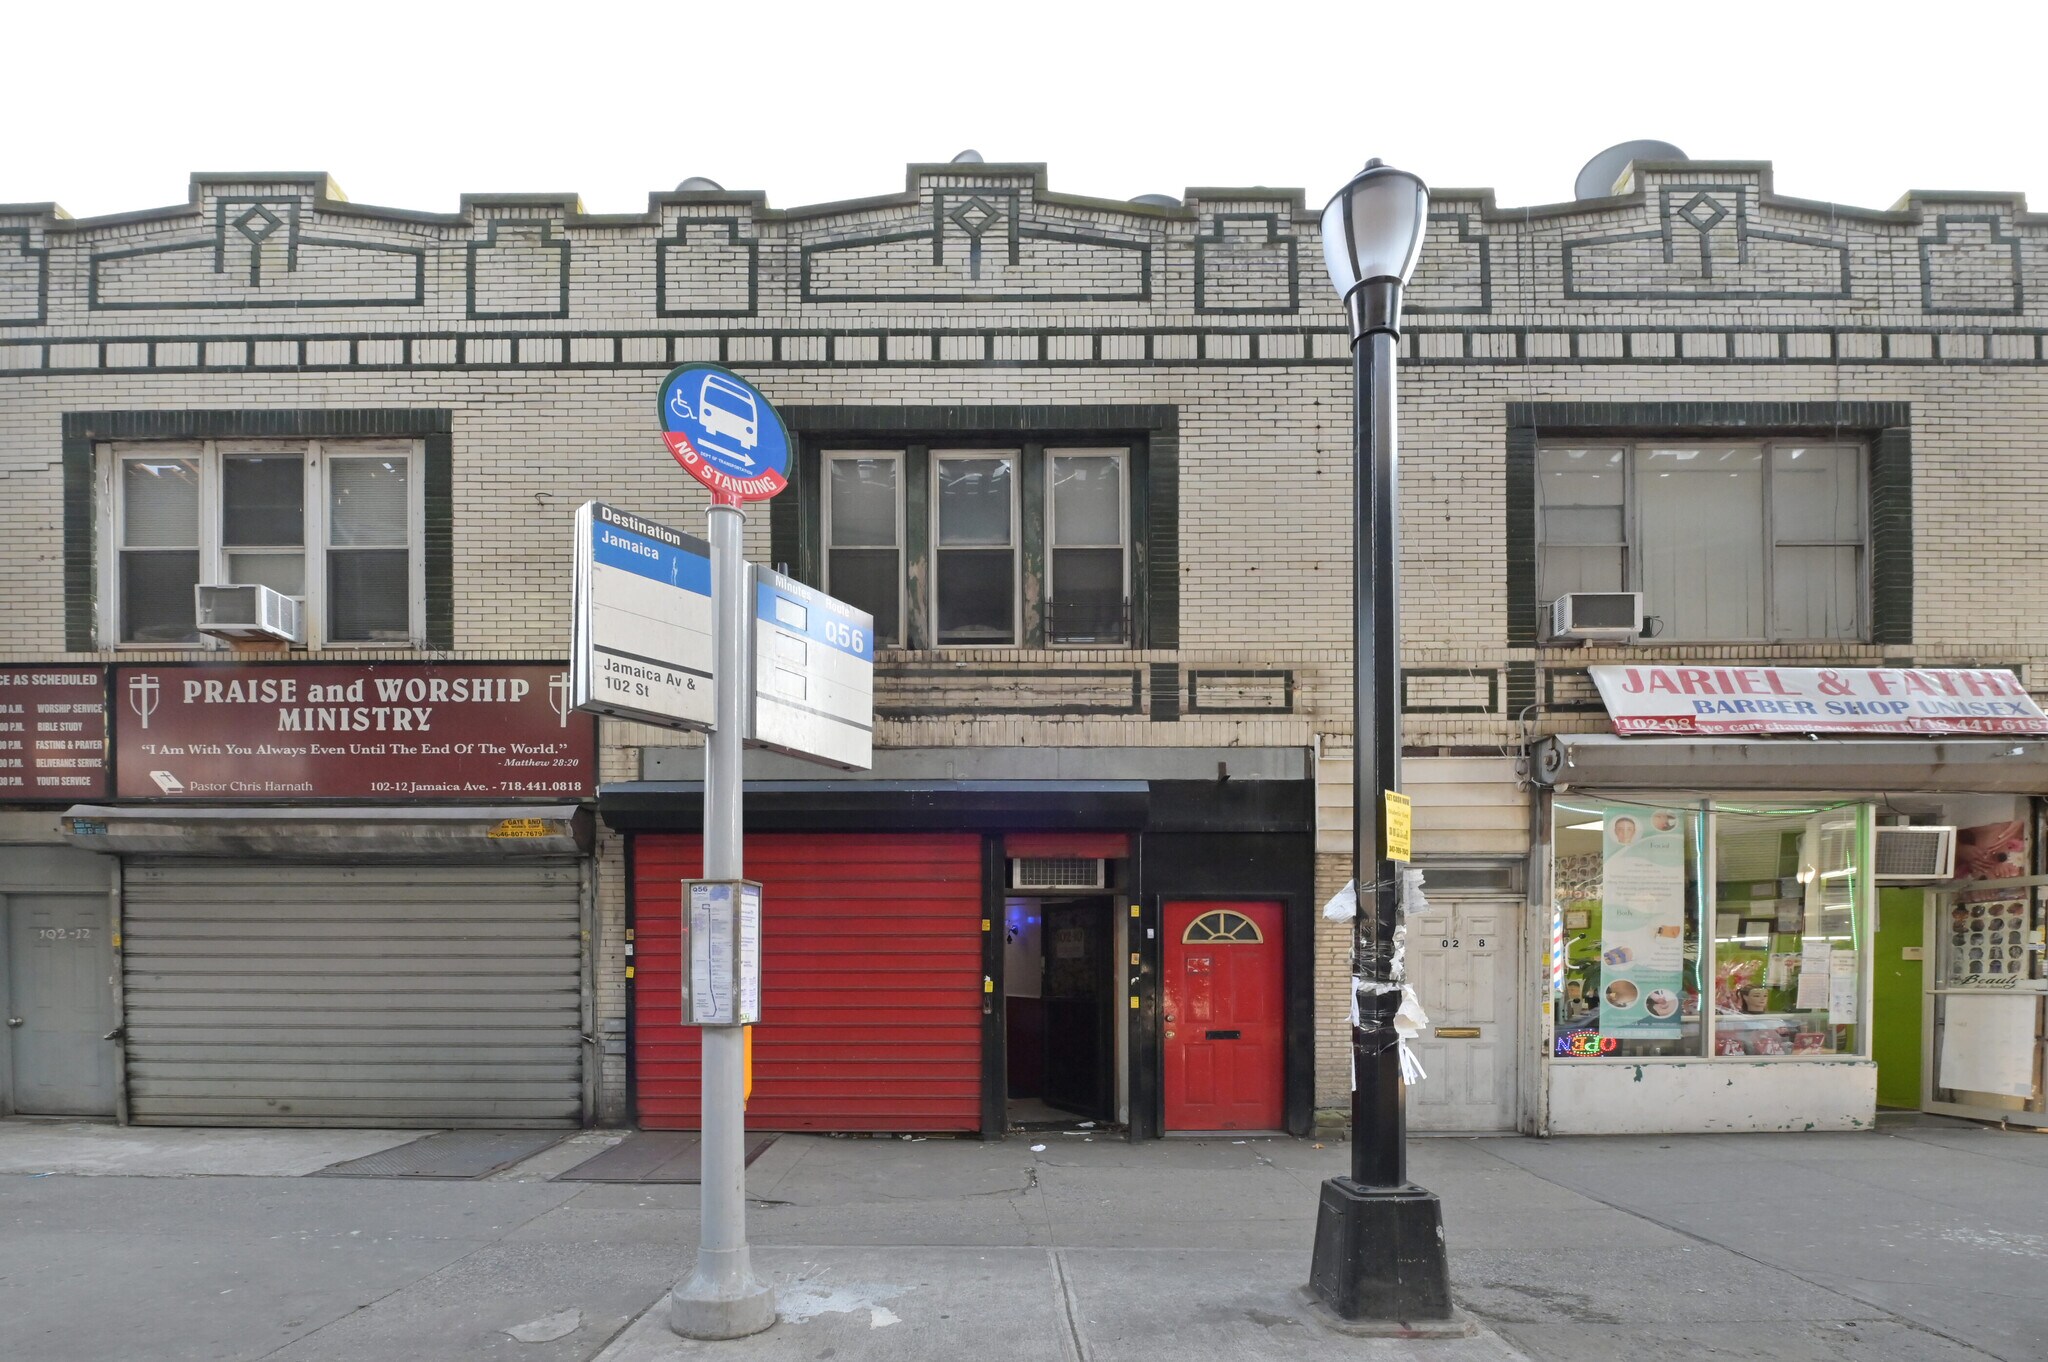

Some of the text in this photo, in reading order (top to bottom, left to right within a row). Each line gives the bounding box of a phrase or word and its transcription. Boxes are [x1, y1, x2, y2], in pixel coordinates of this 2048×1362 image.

[674, 441, 777, 495] NO STANDING
[601, 506, 681, 546] Destination
[601, 530, 660, 560] Jamaica
[775, 575, 851, 617] Minutes Route
[825, 620, 864, 653] Q56
[13, 674, 29, 686] AS
[31, 674, 98, 686] SCHEDULED
[604, 658, 696, 691] Jamaica Av &
[605, 676, 650, 697] 102 St
[1621, 668, 1803, 695] JARIEL
[1817, 670, 1857, 696] &
[183, 678, 530, 703] PRAISE and WORSHIP
[8, 704, 24, 714] A.M.
[37, 703, 72, 714] WORSHIP
[73, 703, 103, 713] SERVICE
[1692, 700, 2032, 716] BARBER SHOP UNISEX
[277, 707, 433, 731] MINISTRY
[1620, 718, 1691, 730] 102-08
[10, 722, 25, 732] P.M.
[37, 722, 59, 732] BIBLE
[60, 722, 83, 732] STUDY
[8, 740, 23, 750] P.M.
[36, 740, 66, 750] FASTING
[67, 740, 74, 750] &
[75, 740, 103, 750] PRAYER
[160, 744, 185, 755] Am
[188, 743, 221, 755] With
[225, 744, 252, 755] You
[256, 743, 307, 758] Always
[310, 743, 346, 754] Even
[350, 743, 386, 754] Until
[389, 743, 418, 754] The
[421, 743, 450, 754] End
[454, 743, 474, 754] Of
[478, 743, 507, 754] The
[9, 758, 24, 768] P.M.
[36, 758, 77, 768] DELIVERANCE
[77, 758, 102, 768] SERVICE
[504, 758, 550, 767] Matthew
[552, 758, 579, 767] 28:20
[9, 776, 24, 786] P.M.
[37, 776, 60, 786] YOUTH
[61, 776, 91, 786] SERVICE
[190, 781, 313, 791] Pastor Chris Harnath
[370, 781, 408, 791] 102-12
[409, 781, 461, 793] Jamaica
[463, 781, 489, 791] Ave.
[500, 781, 582, 791] 718.441.0818
[39, 928, 91, 939] 102-12
[1478, 938, 1485, 947] 8
